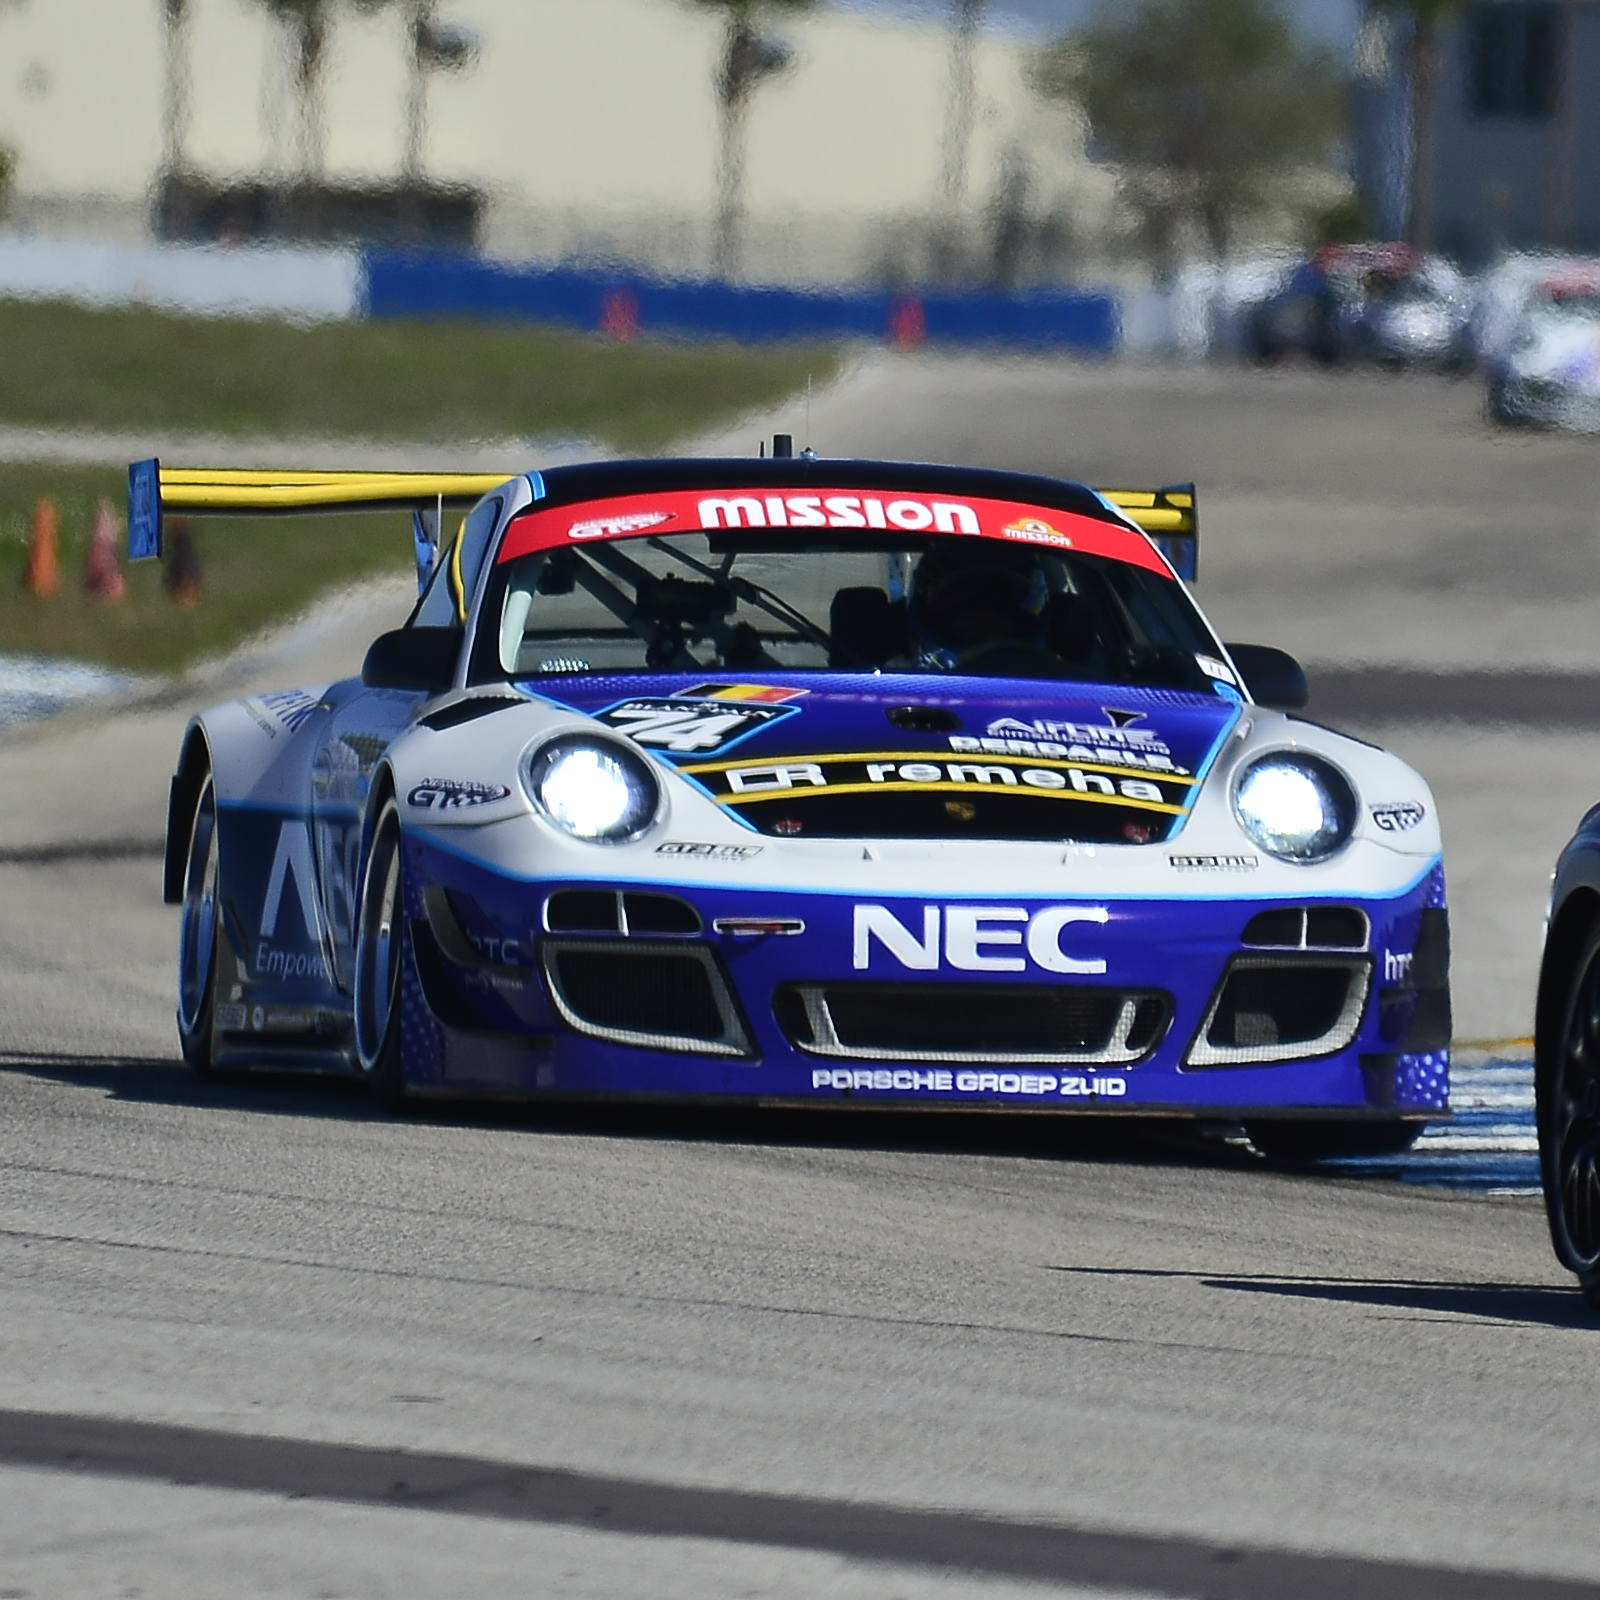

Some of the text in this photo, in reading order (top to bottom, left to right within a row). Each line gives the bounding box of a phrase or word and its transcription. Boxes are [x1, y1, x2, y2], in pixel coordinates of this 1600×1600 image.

[608, 708, 748, 752] 74
[869, 761, 1164, 803] remeha
[852, 903, 1110, 975] NEC
[812, 1068, 1127, 1097] PORSCHE GROEP ZUID
